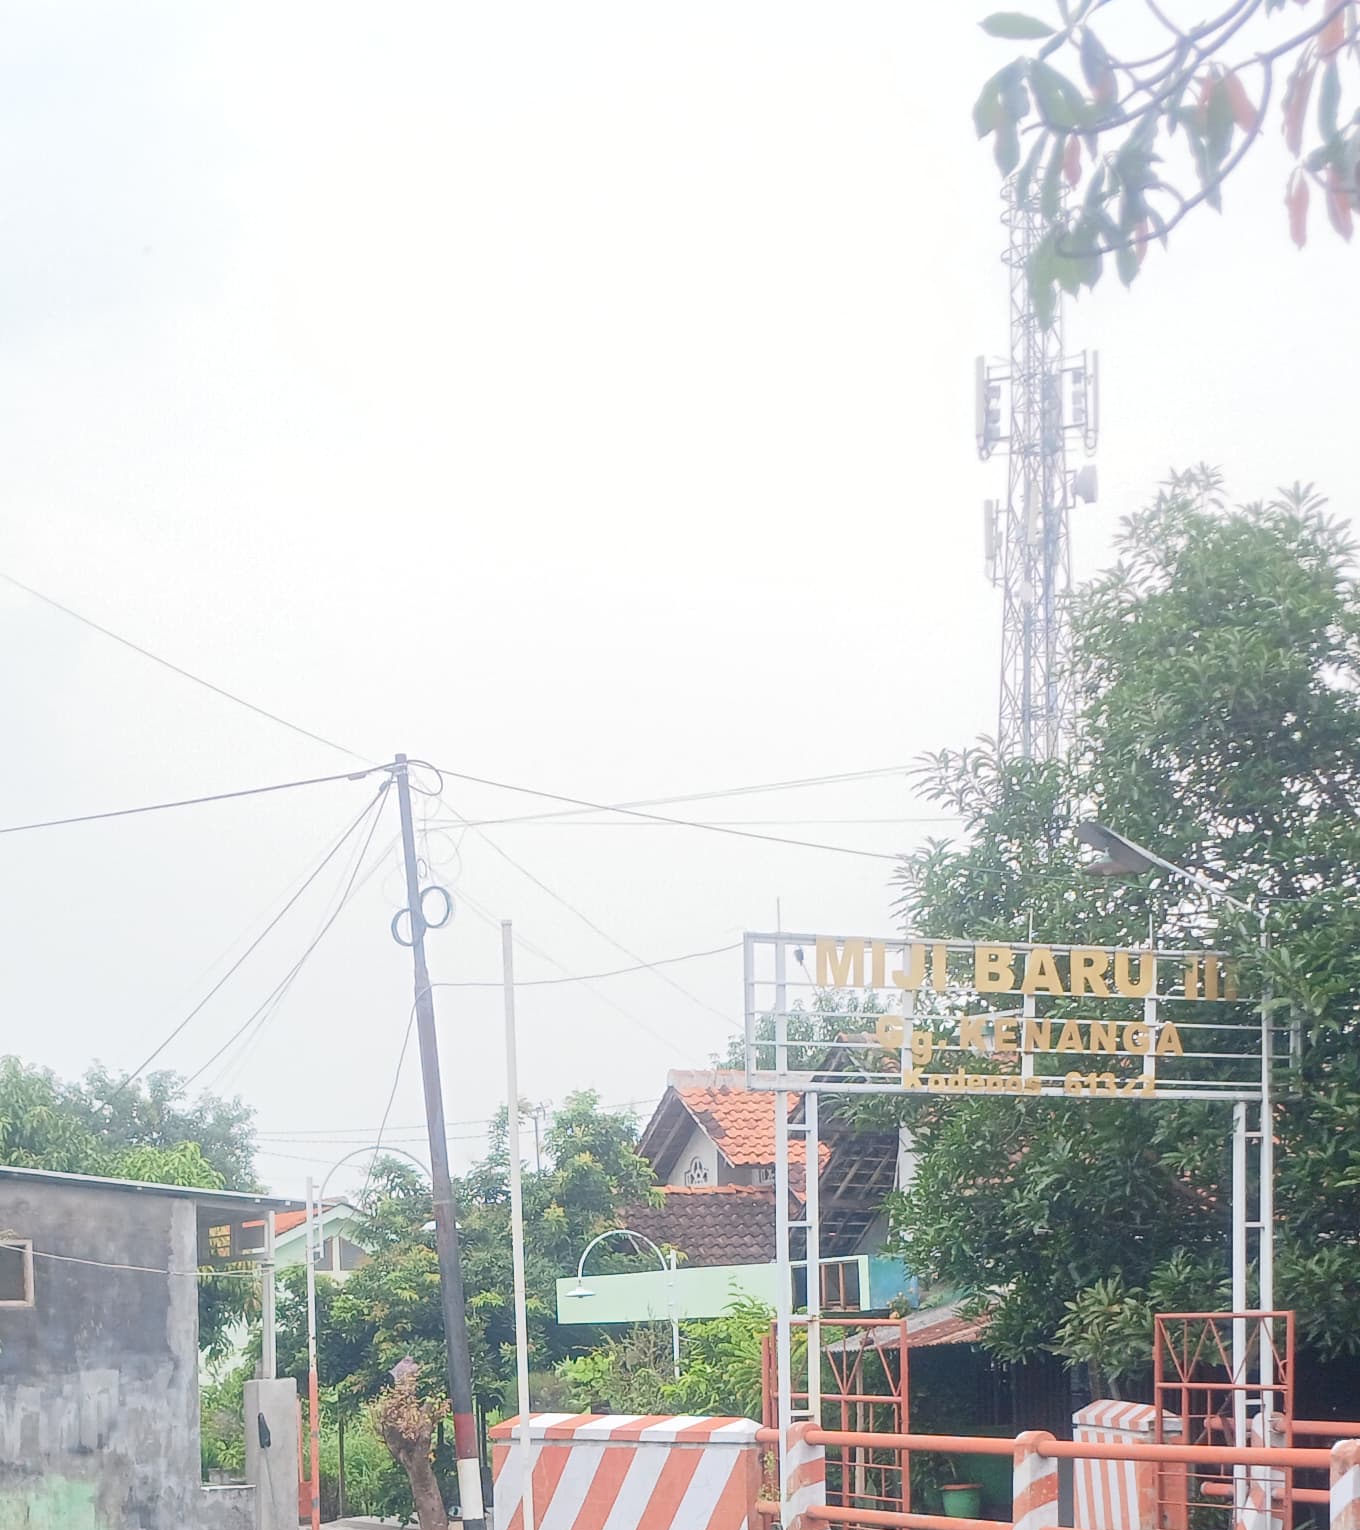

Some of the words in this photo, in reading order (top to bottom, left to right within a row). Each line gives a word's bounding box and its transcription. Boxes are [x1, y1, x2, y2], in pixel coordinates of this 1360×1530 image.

[816, 936, 947, 992] MIJI
[975, 944, 1153, 999] BARU
[876, 1015, 947, 1065] Gg.
[960, 1012, 1184, 1057] KENANGA
